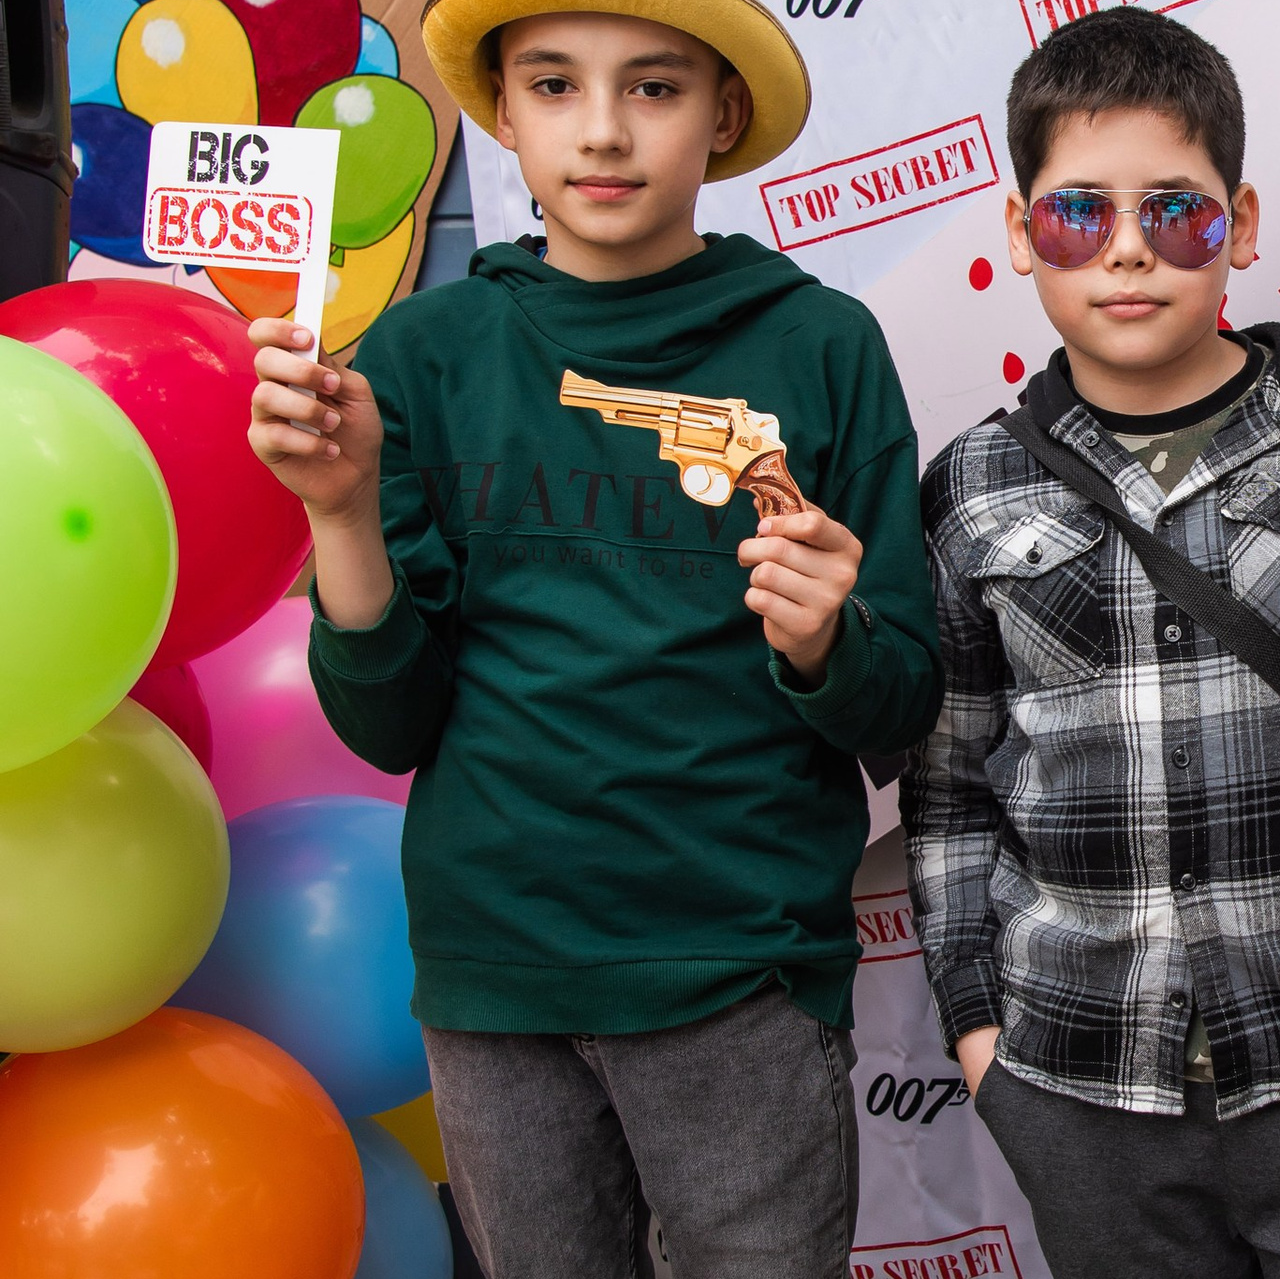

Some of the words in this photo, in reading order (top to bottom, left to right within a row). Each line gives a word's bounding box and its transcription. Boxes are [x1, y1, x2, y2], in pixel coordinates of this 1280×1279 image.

[187, 130, 271, 186] BIG
[778, 183, 841, 230] TOP
[849, 136, 977, 211] SECRET
[157, 194, 302, 256] BOSS
[492, 540, 545, 567] you
[558, 545, 625, 570] want
[638, 554, 665, 576] to
[680, 552, 715, 580] be
[865, 1071, 971, 1125] 007
